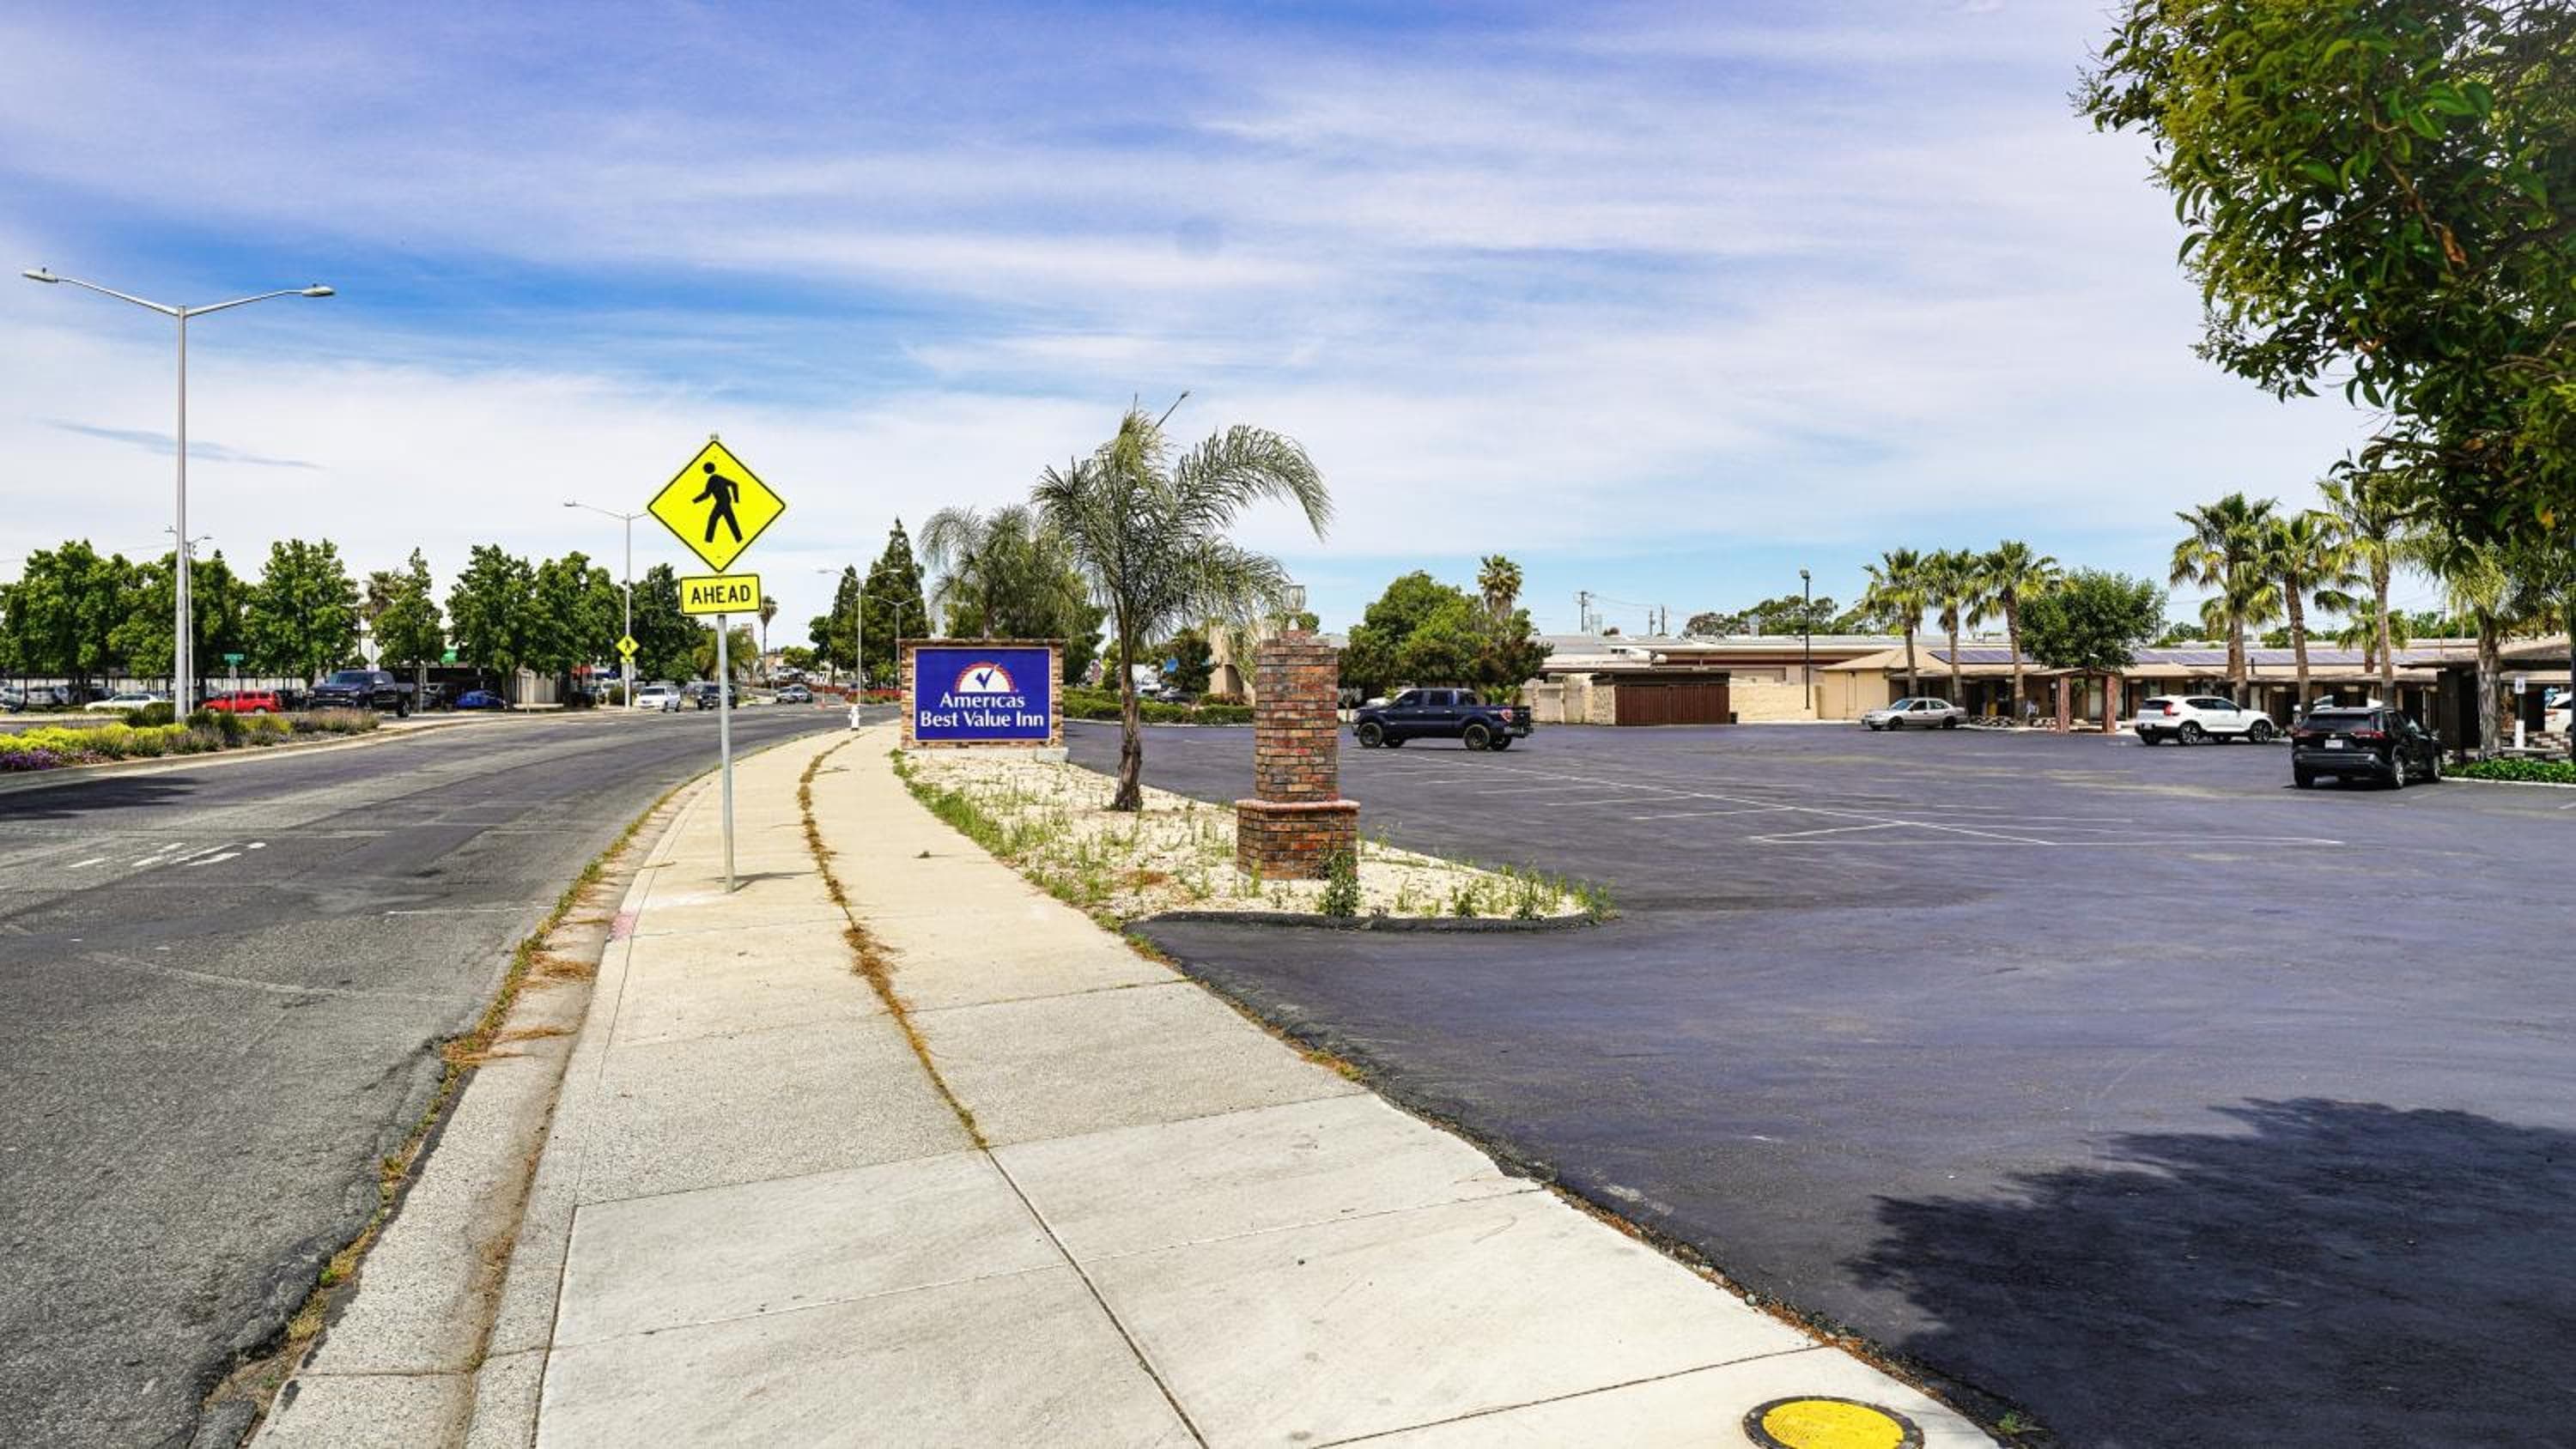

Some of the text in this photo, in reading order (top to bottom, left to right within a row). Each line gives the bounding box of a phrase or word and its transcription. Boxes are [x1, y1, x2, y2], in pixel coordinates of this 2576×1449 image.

[690, 585, 751, 605] AHEAD
[939, 692, 1025, 708] Americas
[920, 709, 1044, 728] Best Value Inn
